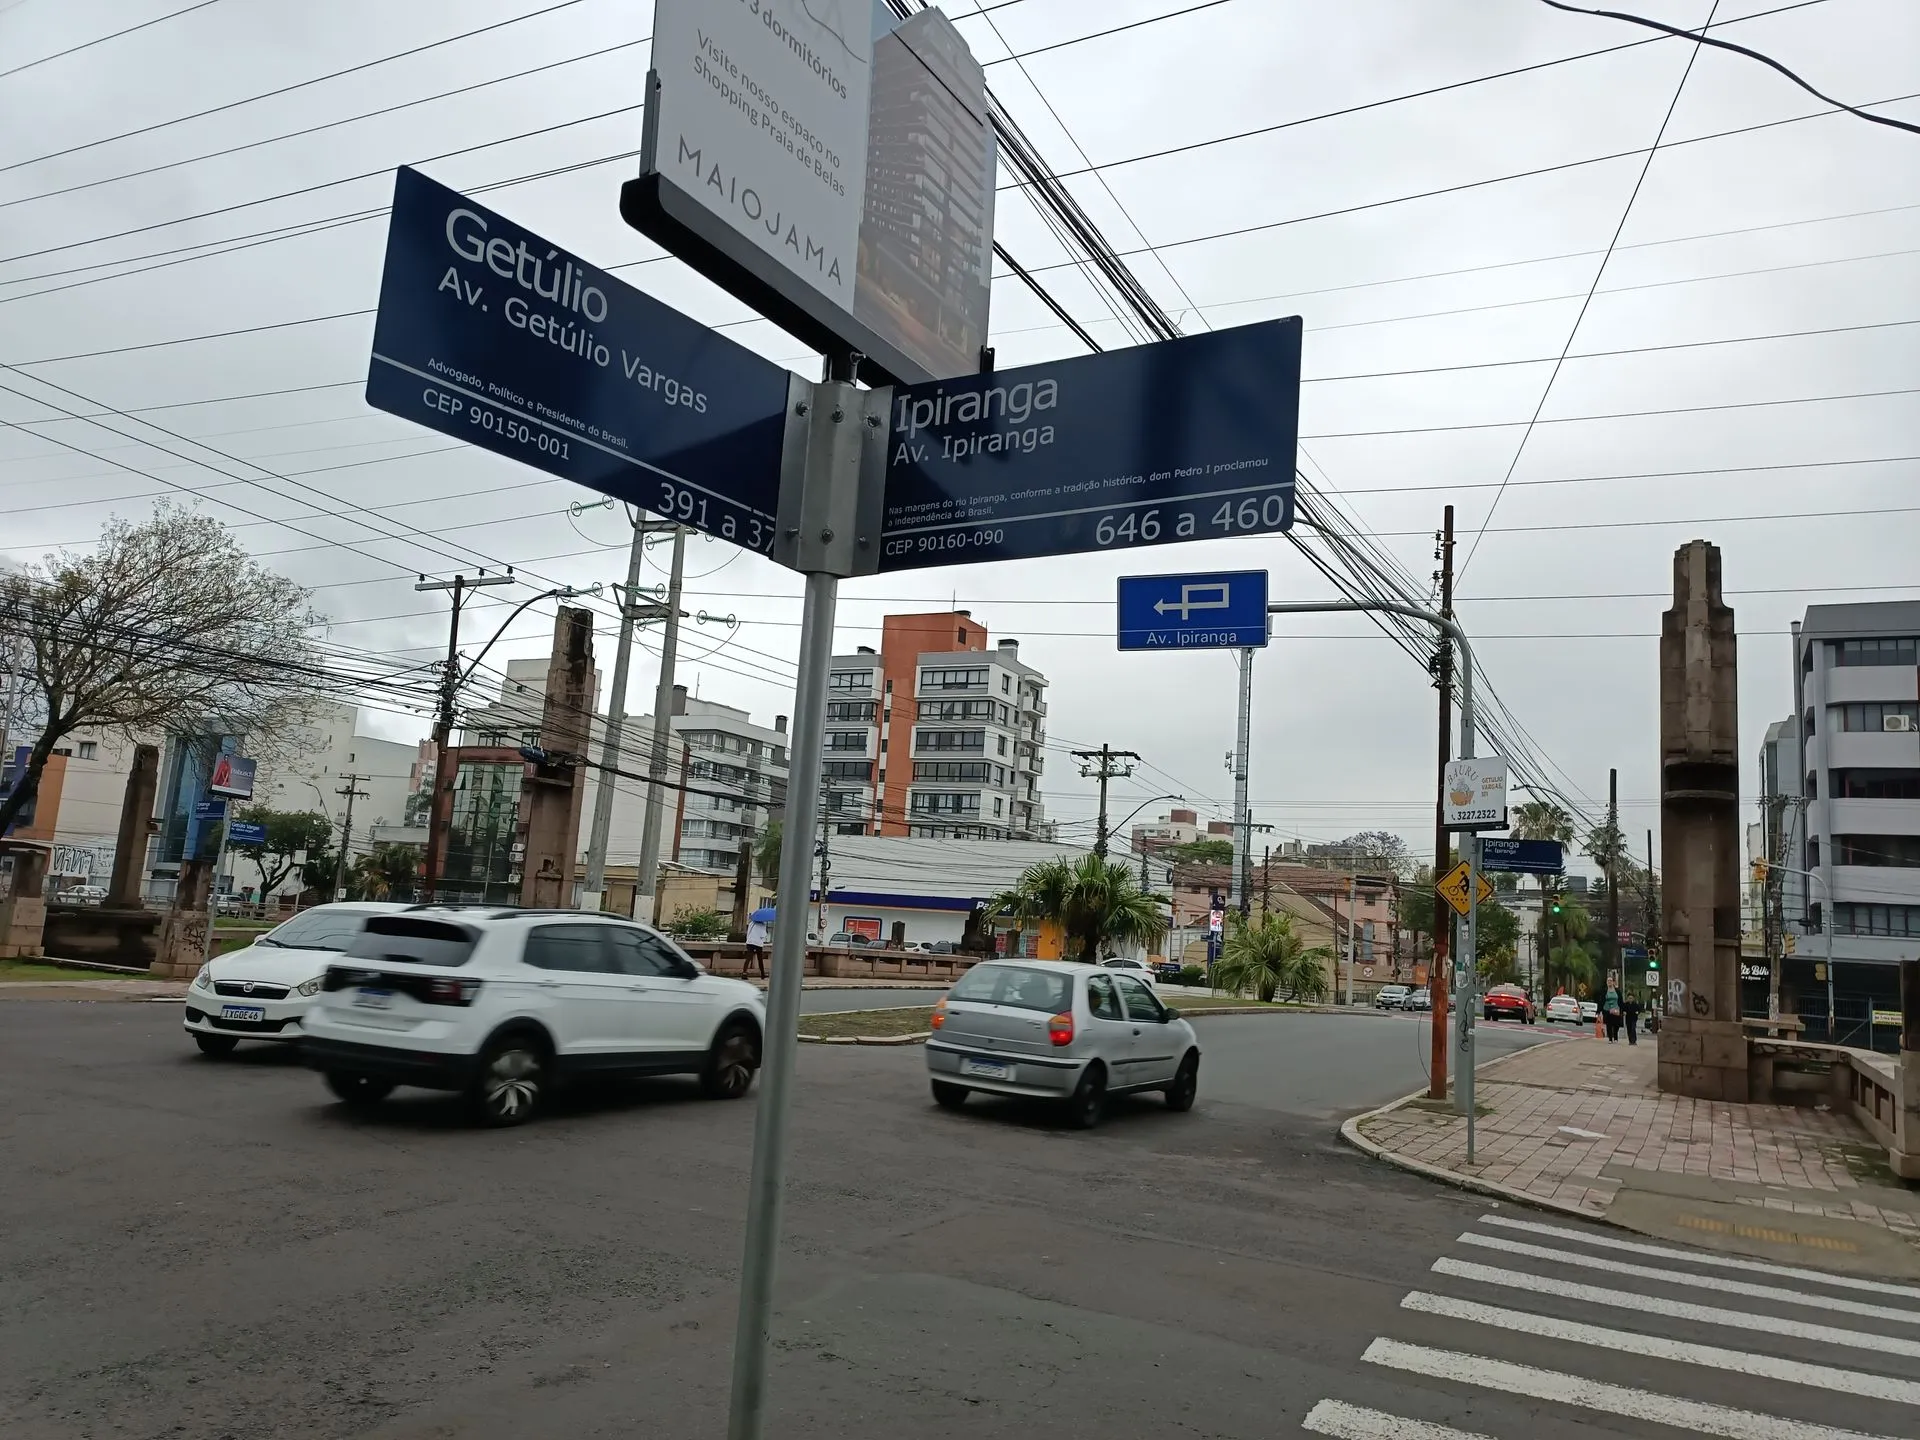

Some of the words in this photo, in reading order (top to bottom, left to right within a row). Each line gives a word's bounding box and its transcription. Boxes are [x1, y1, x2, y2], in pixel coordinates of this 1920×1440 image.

[763, 9, 847, 100] dormitórios
[694, 55, 758, 126] Shopping
[762, 113, 793, 153] Praia
[796, 147, 811, 168] de
[814, 159, 845, 197] Belas
[698, 28, 738, 78] Visite
[741, 73, 778, 114] nosso
[781, 110, 823, 153] espaço
[825, 148, 840, 168] no
[678, 133, 842, 286] MAIOJAMA
[445, 208, 608, 323] Getúlio
[438, 266, 488, 312] Av.
[504, 296, 610, 368] Getúlio
[621, 349, 708, 414] Vargas
[422, 388, 463, 416] CEP
[469, 406, 570, 460] 90150-001
[427, 357, 485, 391] Advogado,
[488, 382, 524, 405] Político
[527, 400, 534, 409] e
[536, 402, 586, 431] Presidente
[588, 424, 600, 436] do
[602, 429, 629, 448] Brasil.
[895, 378, 1058, 439] Ipiranga
[893, 442, 929, 466] Av.
[941, 425, 1055, 463] Ipiranga
[658, 482, 709, 529] 391
[721, 514, 736, 539] a
[888, 506, 903, 515] Nas
[905, 501, 940, 513] margens
[942, 499, 953, 508] do
[955, 498, 967, 506] rio
[969, 493, 1008, 506] Ipiranga,
[1010, 487, 1052, 499] conforme
[1054, 486, 1061, 494] a
[1063, 479, 1100, 493] tradição
[1102, 473, 1147, 488] histórica,
[1149, 471, 1171, 481] dom
[1174, 466, 1203, 478] Pedro
[1205, 464, 1210, 474] I
[1213, 457, 1269, 474] proclamou
[886, 539, 913, 556] CEP
[918, 529, 1004, 552] 90160-090
[888, 519, 893, 527] a
[895, 511, 952, 527] independência
[954, 510, 966, 518] do
[968, 506, 994, 517] Brasil.
[1095, 509, 1161, 546] 646
[1175, 511, 1195, 537] a
[1211, 494, 1284, 531] 460
[1146, 631, 1171, 645] Av.
[1177, 631, 1237, 646] Ipiranga
[1447, 765, 1479, 785] BAURU
[1457, 809, 1496, 820] 3227.2322
[1485, 839, 1519, 849] Ipiranga
